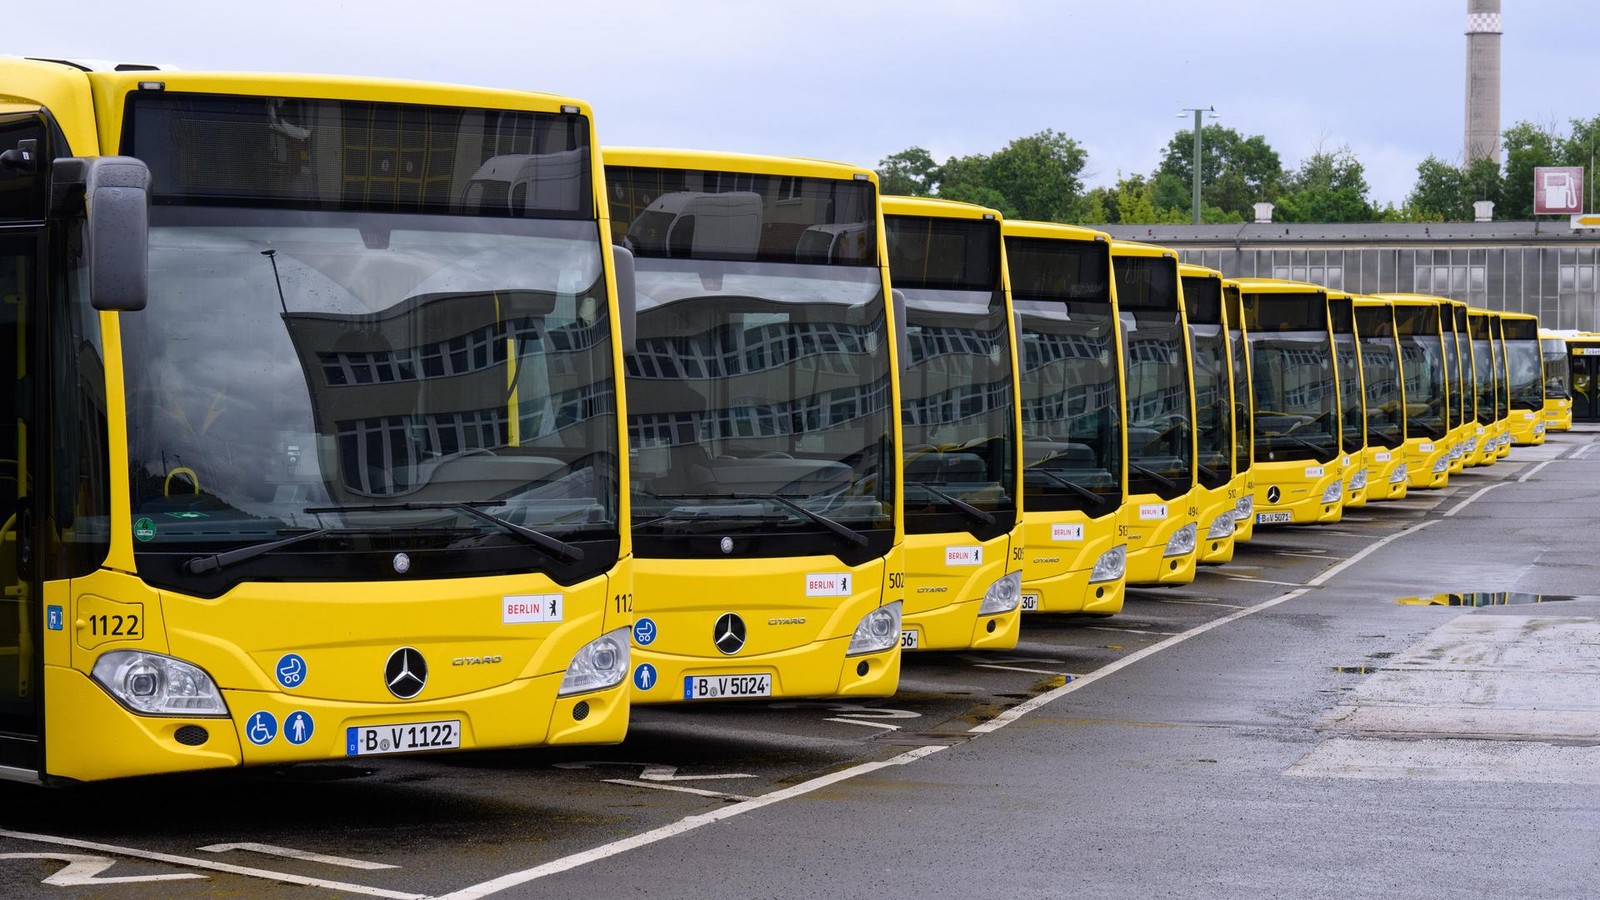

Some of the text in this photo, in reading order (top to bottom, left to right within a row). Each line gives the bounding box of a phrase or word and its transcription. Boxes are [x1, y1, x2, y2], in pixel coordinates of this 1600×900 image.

[1262, 514, 1267, 522] B
[809, 581, 835, 590] BERLIN
[507, 604, 540, 614] BERLIN
[89, 615, 139, 636] 1122
[768, 617, 806, 625] CITARO
[452, 655, 503, 666] CITARO
[699, 678, 709, 696] B
[719, 678, 728, 695] V
[731, 676, 766, 695] 5024
[366, 730, 379, 751] B
[392, 728, 403, 749] V
[408, 724, 452, 748] 1122
